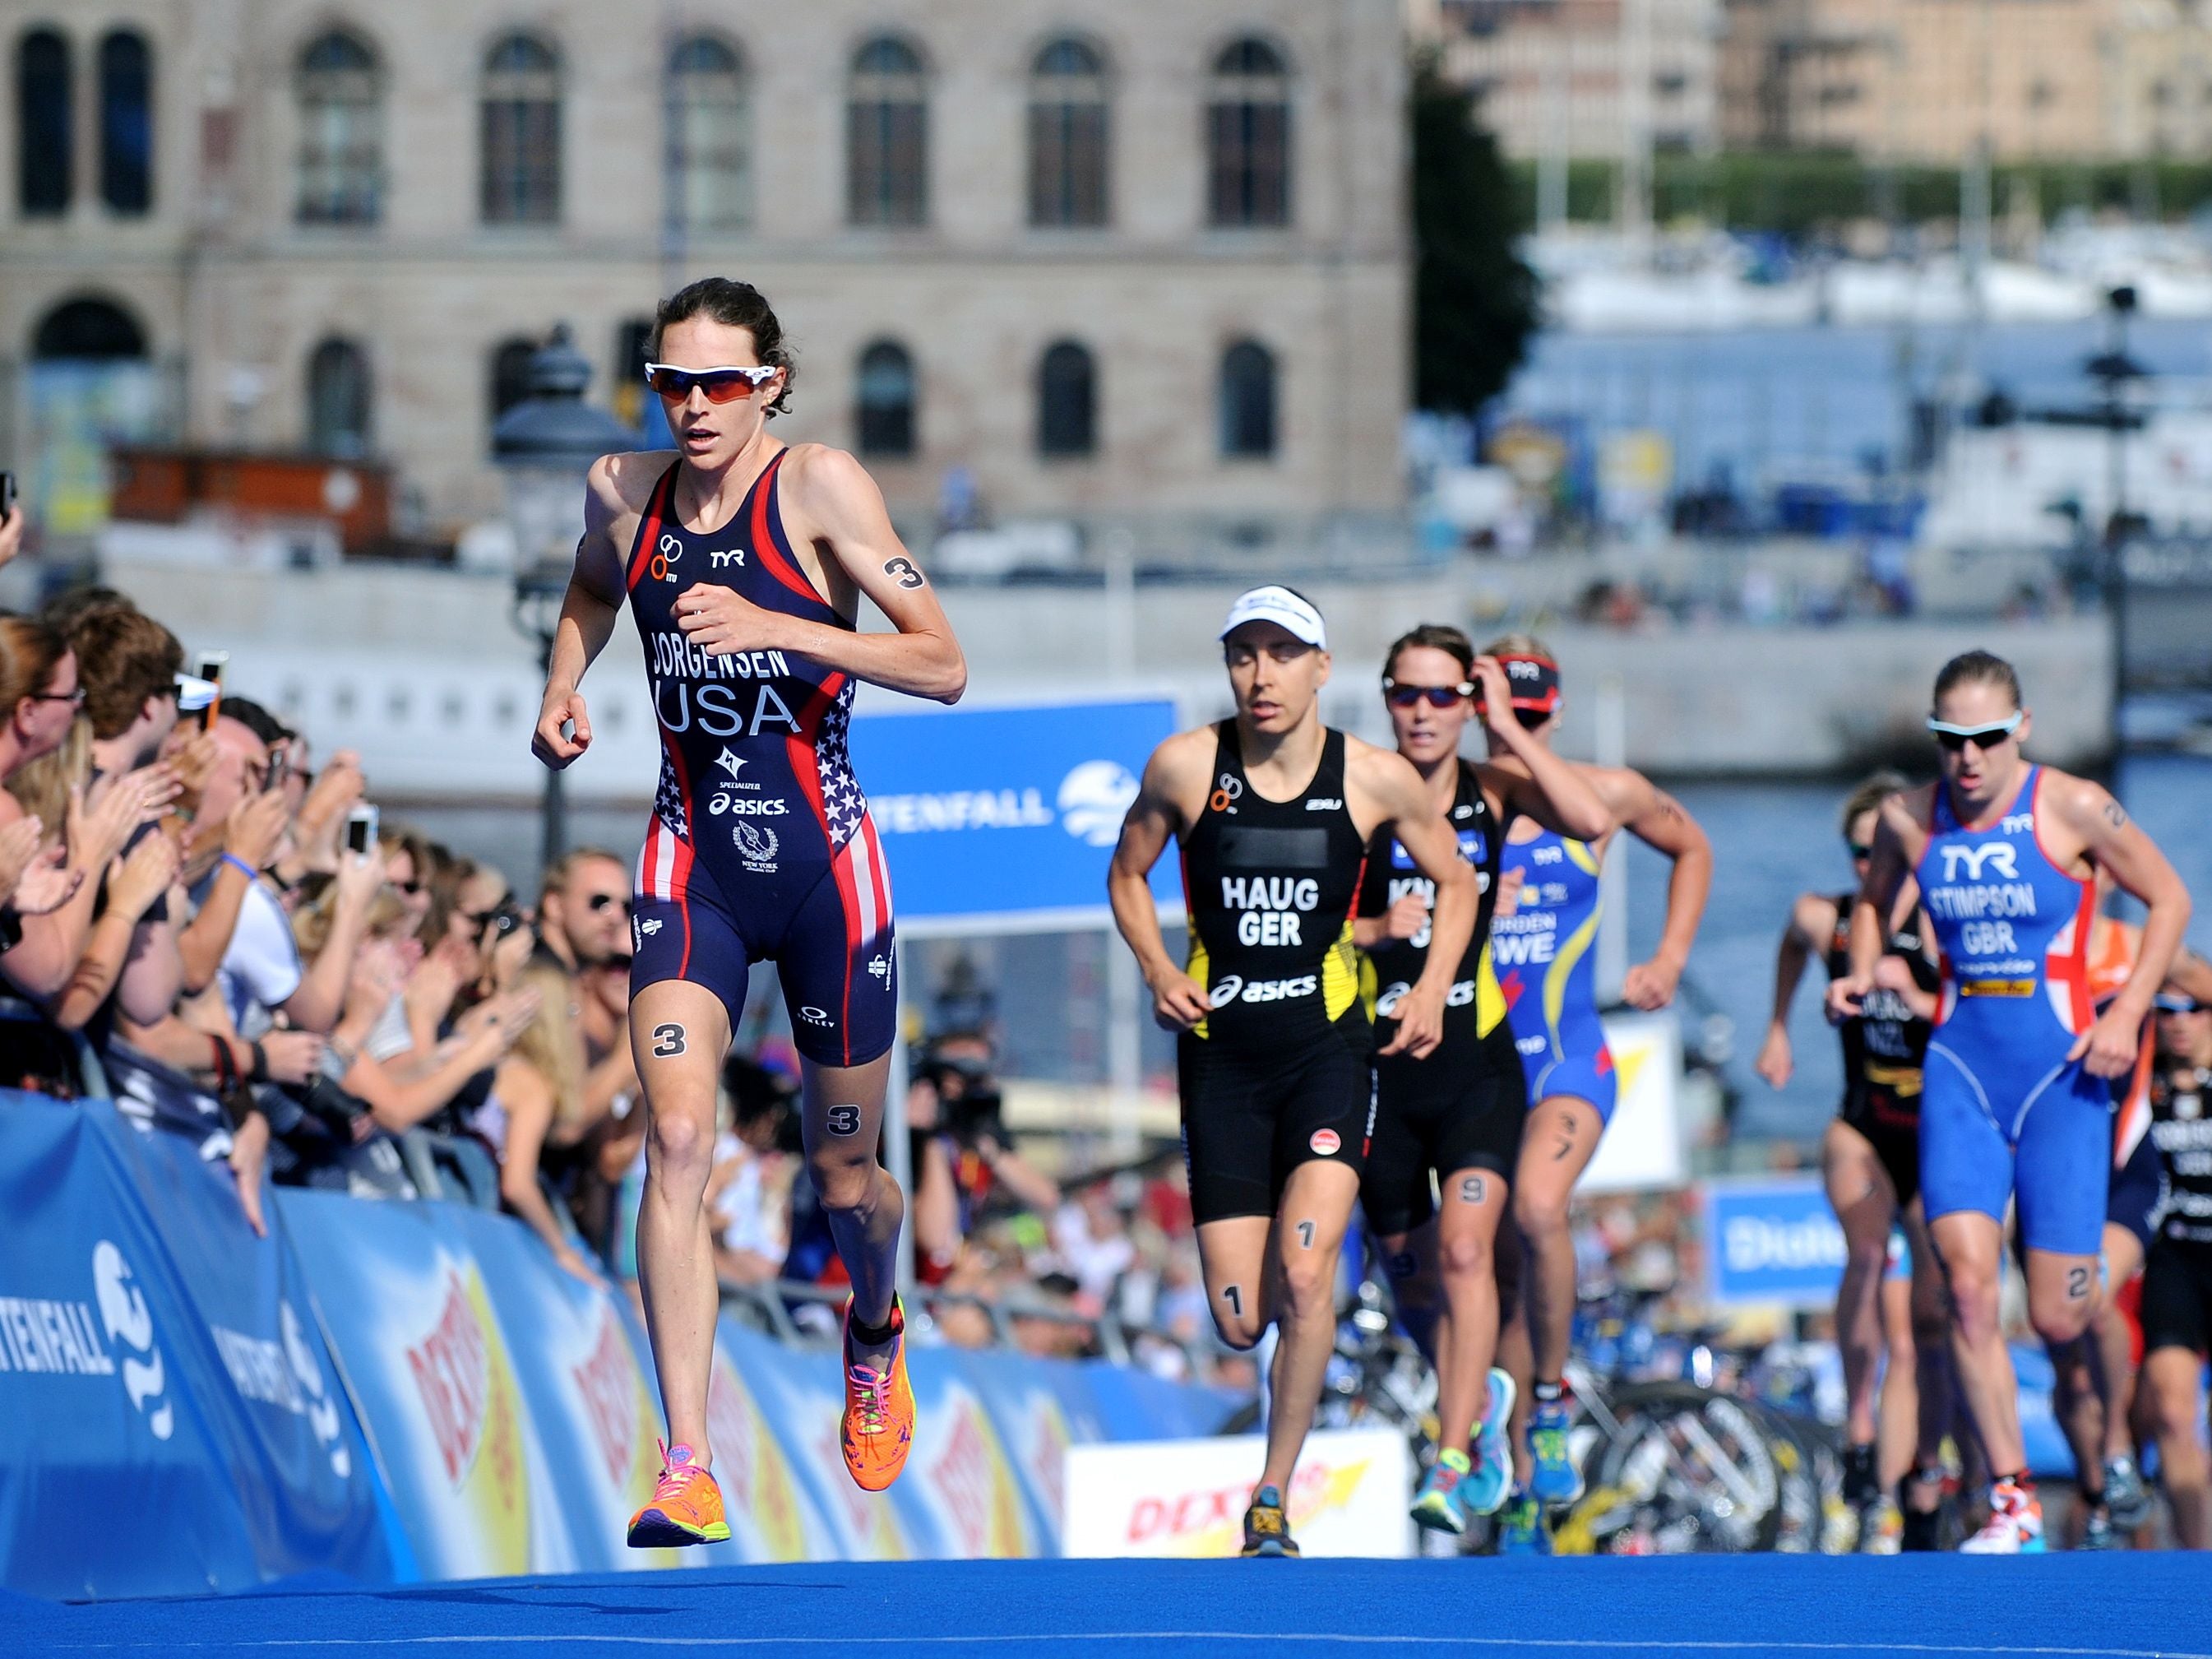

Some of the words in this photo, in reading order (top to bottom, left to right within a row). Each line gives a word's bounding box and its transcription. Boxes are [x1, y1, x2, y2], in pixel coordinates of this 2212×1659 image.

[710, 549, 745, 568] TYR
[882, 556, 925, 590] 3
[651, 632, 790, 679] JORGENSEN
[655, 679, 803, 736] USA
[1940, 841, 2020, 883] TYR
[1221, 876, 1319, 911] HAUG
[1928, 883, 2037, 920] STIMPSON
[1238, 911, 1303, 947] GER
[1960, 920, 2019, 956] GBR
[1242, 975, 1317, 1003] asics
[653, 1022, 687, 1059] 3
[827, 1105, 861, 1136] 3
[1458, 1175, 1488, 1204] 9
[1296, 1221, 1317, 1250] 1
[2068, 1267, 2089, 1299] 2
[1223, 1284, 1244, 1317] 1
